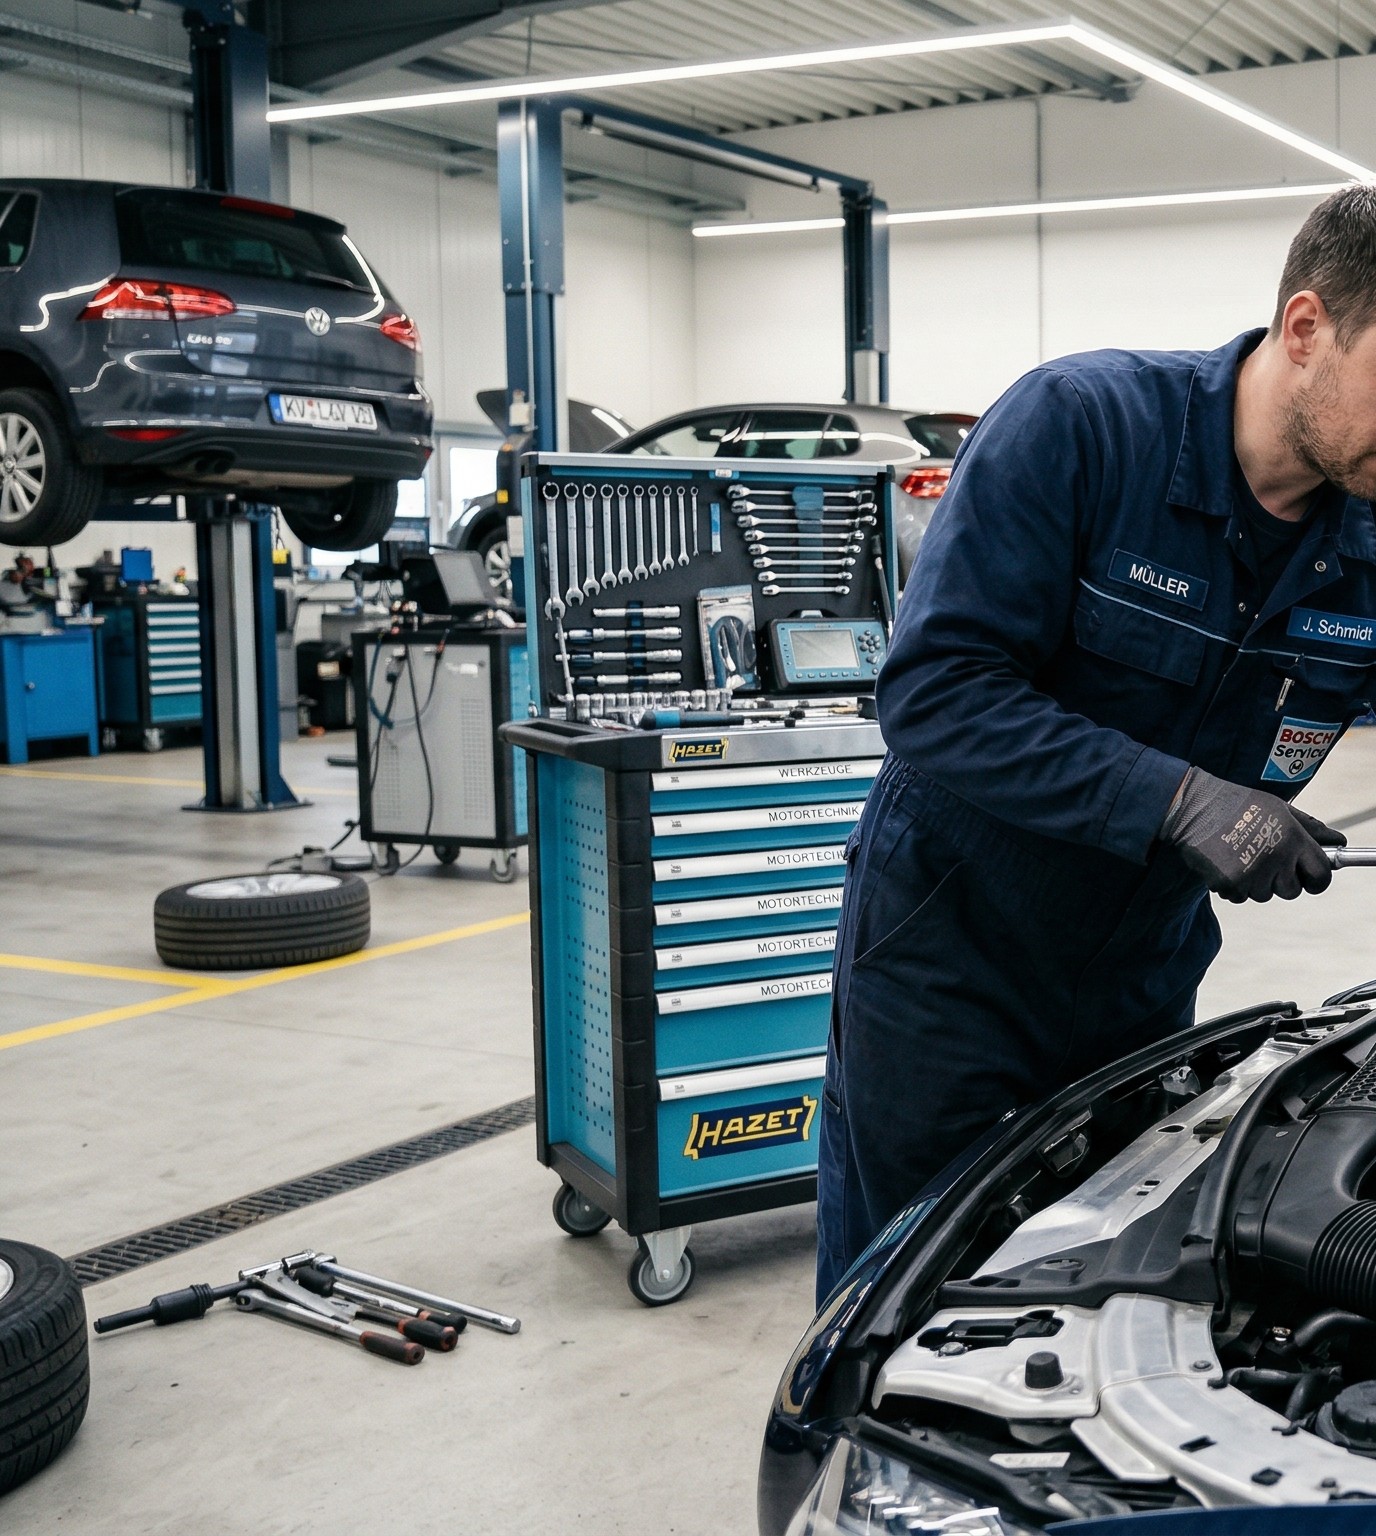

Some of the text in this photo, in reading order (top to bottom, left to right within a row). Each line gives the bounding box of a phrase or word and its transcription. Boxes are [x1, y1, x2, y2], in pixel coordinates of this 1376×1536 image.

[1129, 563, 1190, 598] MÜLLER
[1302, 616, 1373, 641] J. Schmidt
[1279, 728, 1335, 745] BOSCH
[674, 743, 723, 758] HAZET
[779, 764, 853, 778] WERKZEUGE
[768, 806, 860, 822] MOTORTECHNIK
[697, 1107, 804, 1149] HAZET
